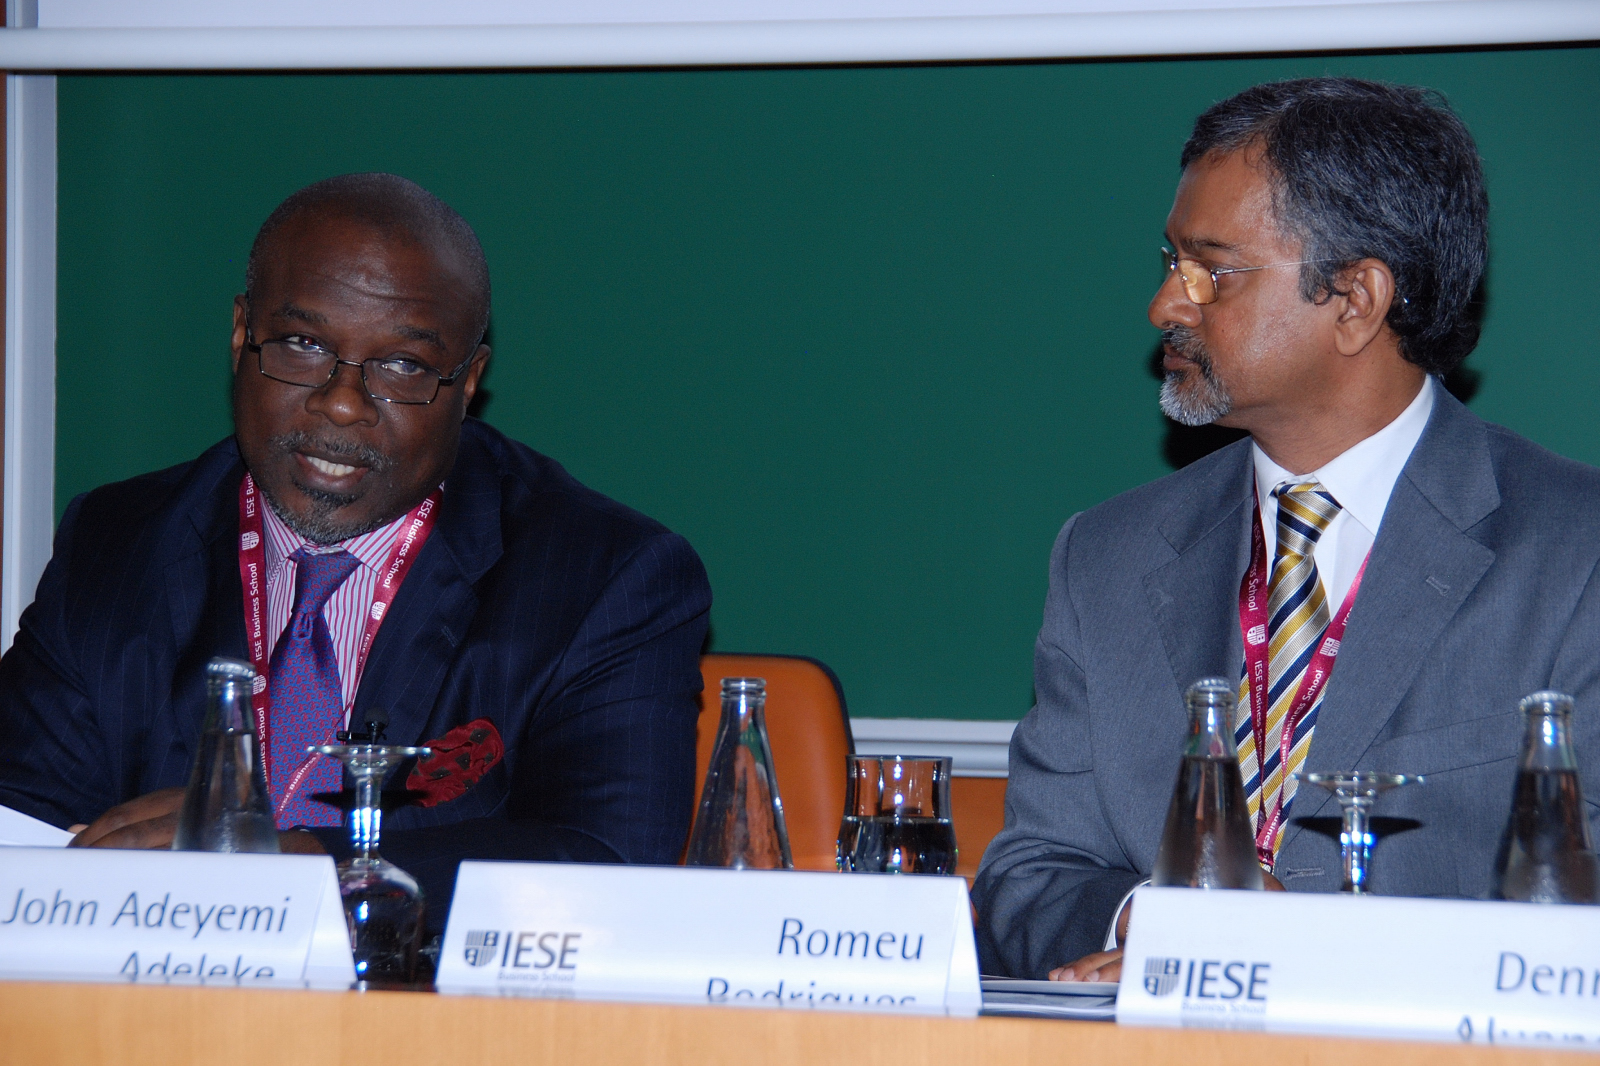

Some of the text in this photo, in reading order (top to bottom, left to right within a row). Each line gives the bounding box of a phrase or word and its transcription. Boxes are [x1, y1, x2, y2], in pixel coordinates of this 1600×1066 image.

[246, 496, 255, 518] IESE
[382, 498, 435, 589] IESE Business School
[247, 562, 263, 661] IESE Business School
[1248, 578, 1259, 612] School
[1254, 660, 1263, 682] IESE
[256, 707, 266, 741] School
[1255, 684, 1264, 727] Business
[1282, 702, 1307, 741] Business
[1302, 669, 1324, 701] School
[289, 757, 316, 790] Business
[0, 888, 292, 940] John Adeyemi
[501, 931, 582, 970] IESE
[776, 917, 926, 961] Romeu
[541, 971, 576, 982] School
[1184, 959, 1271, 1001] IESE
